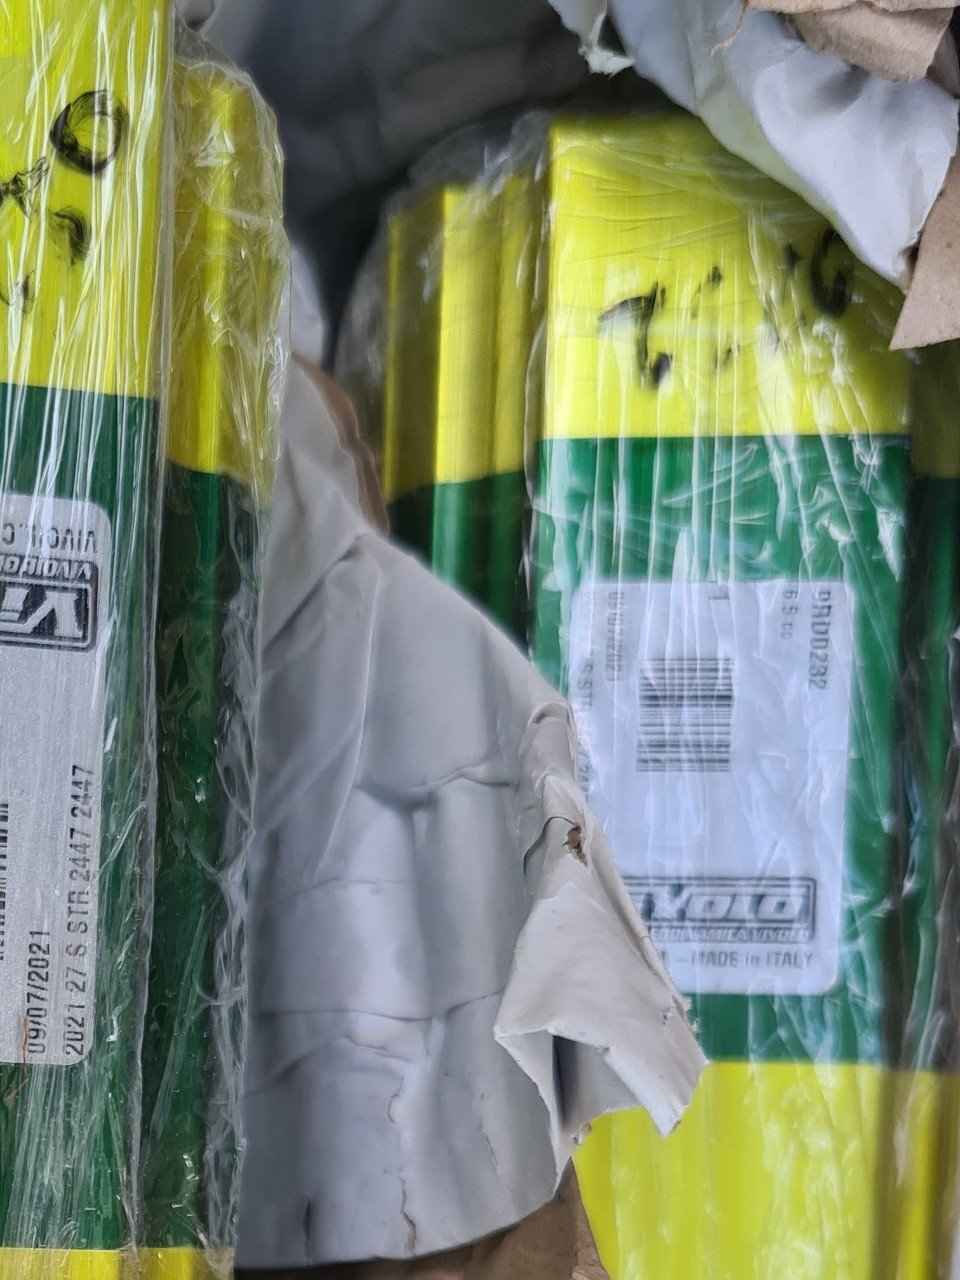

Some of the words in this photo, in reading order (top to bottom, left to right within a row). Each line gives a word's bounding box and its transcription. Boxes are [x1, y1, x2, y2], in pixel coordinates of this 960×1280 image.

[781, 590, 798, 615] 65
[807, 589, 832, 690] 9RD0232
[69, 765, 94, 818] 2447
[68, 827, 92, 881] 2447
[67, 890, 90, 935] STR
[66, 943, 88, 957] S
[692, 949, 738, 969] MADE
[745, 950, 760, 968] in
[766, 951, 814, 969] ITALY
[25, 929, 51, 1055] 09/07/2021
[64, 968, 88, 993] 27
[61, 1003, 87, 1057] 2021
